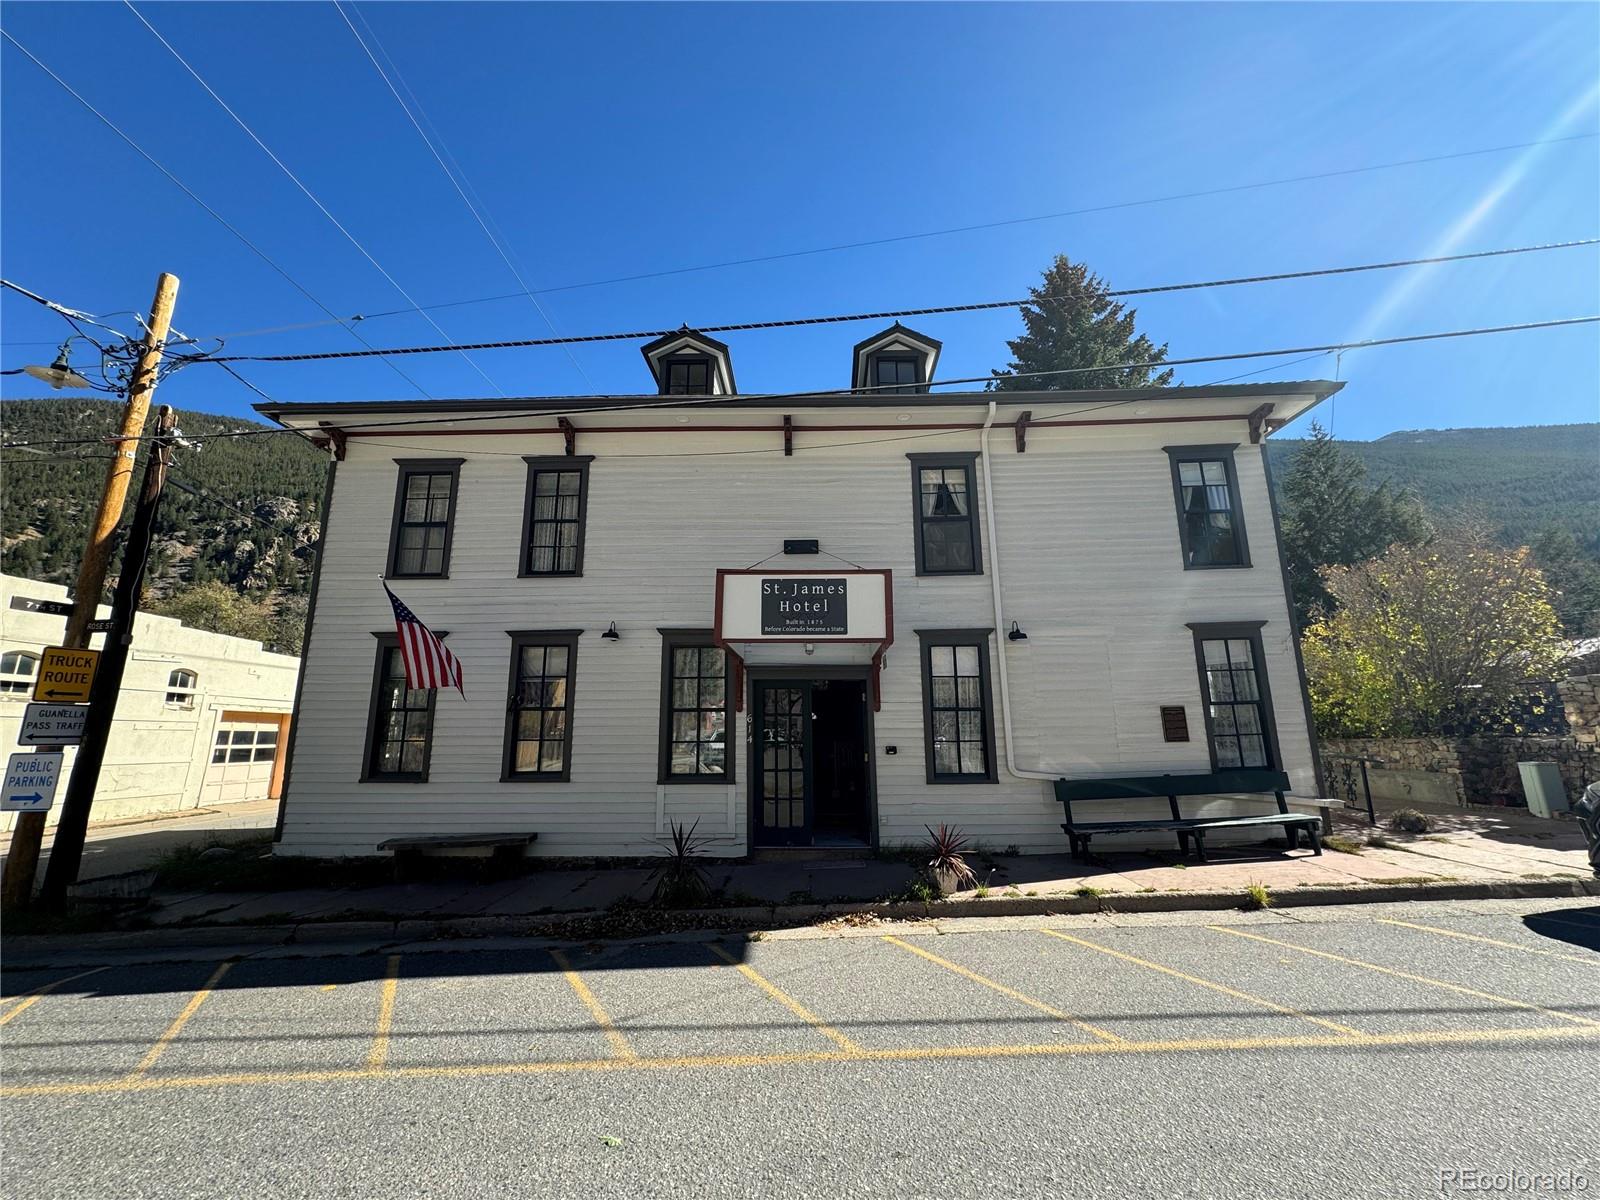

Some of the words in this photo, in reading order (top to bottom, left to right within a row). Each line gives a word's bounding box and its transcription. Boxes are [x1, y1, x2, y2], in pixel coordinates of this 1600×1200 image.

[763, 583, 787, 595] St.
[791, 583, 845, 597] James
[25, 601, 46, 610] 7TH
[49, 604, 63, 613] ST
[779, 599, 829, 612] Hotel
[87, 622, 104, 630] ROSE
[105, 622, 114, 630] ST
[48, 655, 94, 669] TRUCK
[44, 671, 90, 685] ROUTE
[38, 709, 85, 719] GUANELLA
[25, 722, 52, 730] PASS
[56, 722, 85, 730] TRAFF
[15, 761, 54, 773] PUBLIC
[8, 775, 54, 788] PARKING
